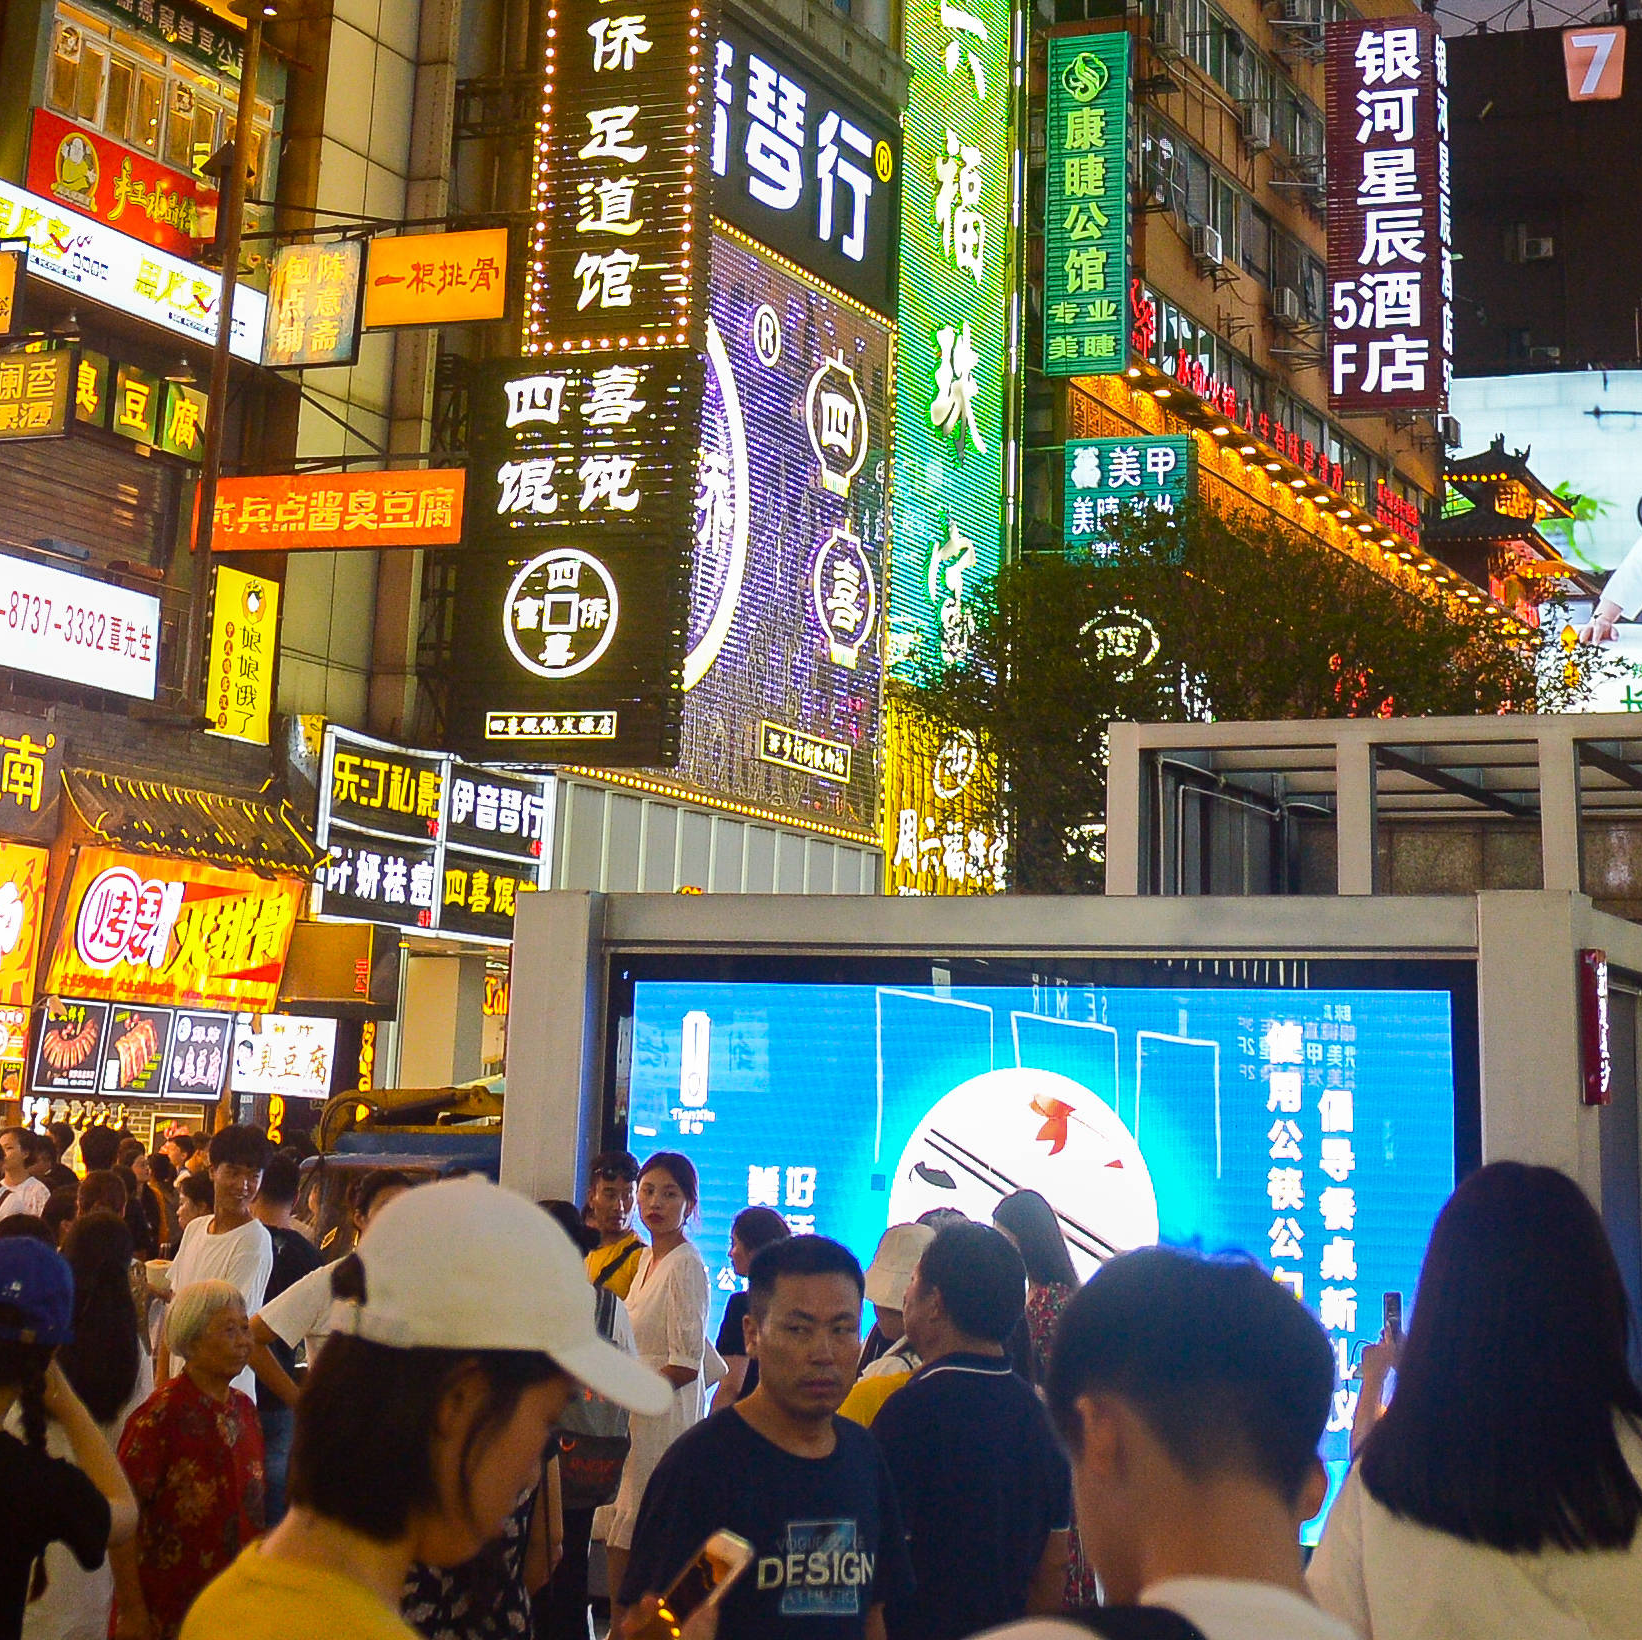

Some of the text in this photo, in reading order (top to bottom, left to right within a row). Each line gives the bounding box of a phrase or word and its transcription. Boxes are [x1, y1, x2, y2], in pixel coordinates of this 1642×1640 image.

[1569, 36, 1612, 95] 7
[1062, 106, 1110, 293] 康睫公馆
[1355, 26, 1430, 395] 银河星辰酒店
[444, 871, 536, 918] 四喜馄
[757, 1552, 875, 1591] DESIGN
